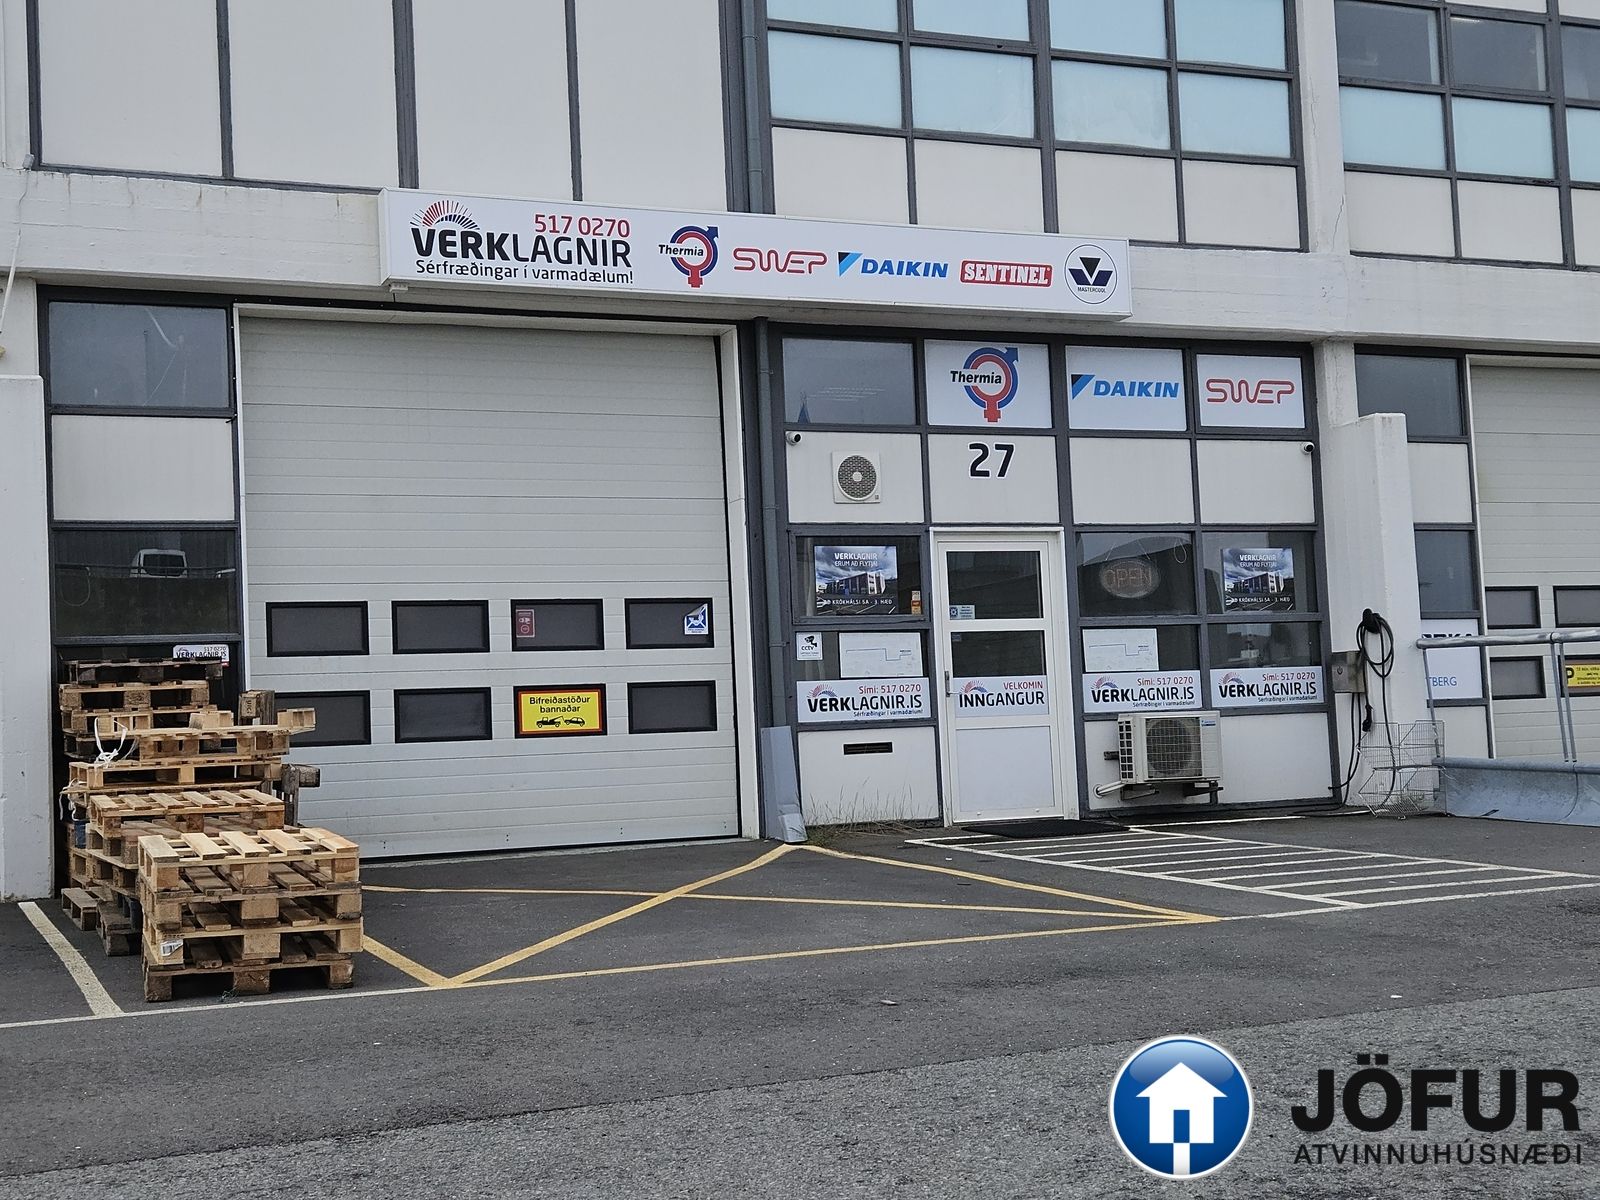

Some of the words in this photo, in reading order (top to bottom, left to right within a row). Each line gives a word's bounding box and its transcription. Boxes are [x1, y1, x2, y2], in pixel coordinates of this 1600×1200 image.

[535, 214, 573, 234] 517
[578, 216, 630, 238] 0270
[411, 227, 632, 268] VERKLAGNIR
[658, 244, 704, 257] Thermia
[733, 247, 828, 274] SWEP
[860, 258, 948, 278] DAIKIN
[416, 259, 519, 281] Sérfræðingar
[524, 264, 528, 279] í
[533, 266, 634, 284] varmadælum!
[964, 262, 1050, 285] SENTINEL
[950, 370, 1002, 384] Thermia
[1093, 379, 1180, 398] DAIKIN
[1205, 378, 1295, 404] SWEP
[968, 442, 1016, 478] 27
[834, 552, 878, 560] VERKLAGNIR
[1104, 567, 1152, 588] OPEN
[1158, 677, 1172, 686] 517
[1174, 676, 1194, 685] 0270
[1281, 672, 1295, 680] 517
[1296, 672, 1316, 680] 0270
[880, 684, 896, 694] 517
[899, 684, 922, 692] 0270
[1003, 681, 1044, 690] VELKOMIN
[1218, 682, 1317, 698] VERKLAGNIR.IS
[529, 696, 591, 705] Bifreiðastöður
[807, 694, 922, 712] VERKLAGNIR.IS
[959, 691, 1045, 708] INNGANGUR
[1091, 686, 1194, 704] VERKLAGNIR.IS
[540, 704, 581, 714] bannaðar
